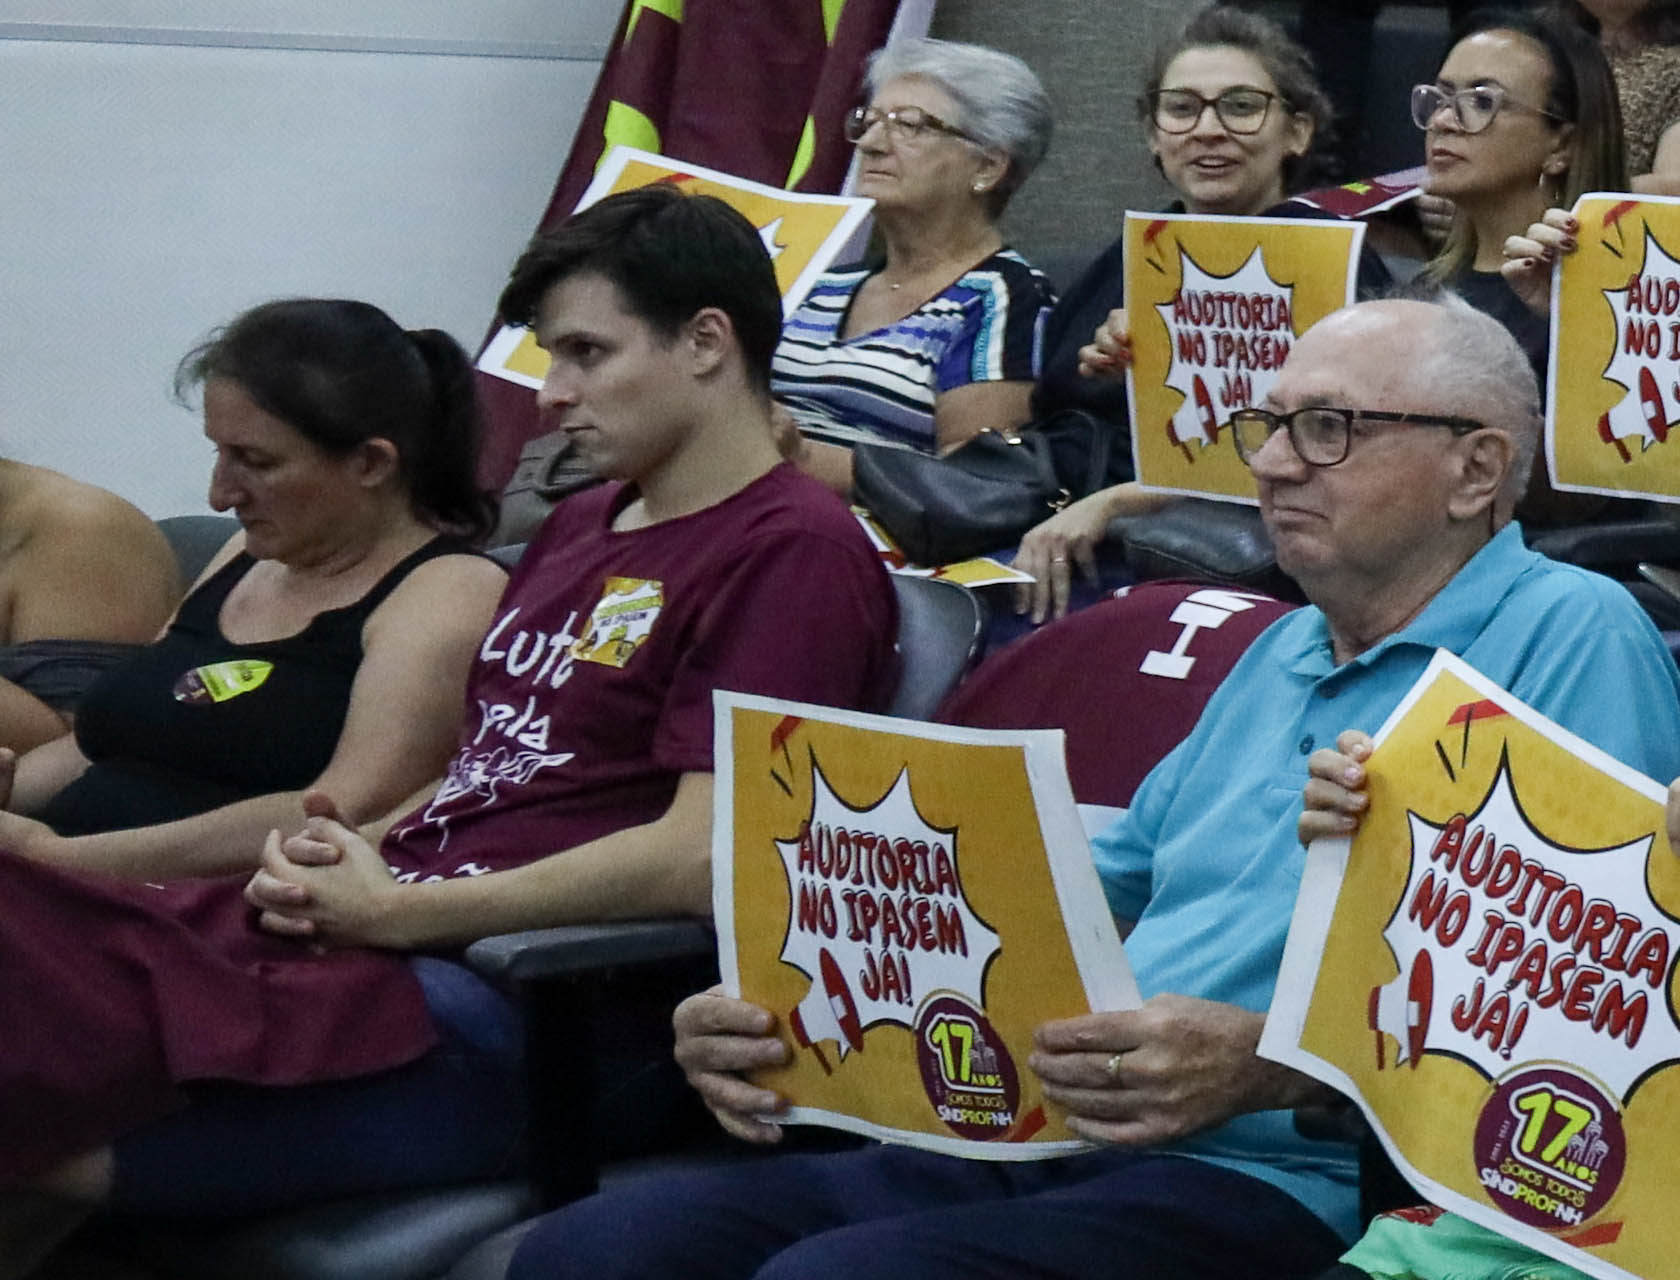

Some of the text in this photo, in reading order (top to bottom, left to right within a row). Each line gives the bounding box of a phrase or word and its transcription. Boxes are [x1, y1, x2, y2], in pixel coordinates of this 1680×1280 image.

[1174, 289, 1292, 332] AUDITORIA
[1624, 317, 1662, 359] NO
[1178, 332, 1291, 373] NO IPASEM
[798, 820, 957, 898] AUDITORIA
[799, 878, 968, 958] NO IPASEM
[1430, 812, 1671, 993] AUDITORIA
[860, 947, 913, 1007] JÁ!
[1408, 869, 1649, 1050] NO IPASEM
[931, 1022, 974, 1083] 17
[1450, 976, 1530, 1062] JÁ!
[1516, 1089, 1599, 1185] 17 ANOS
